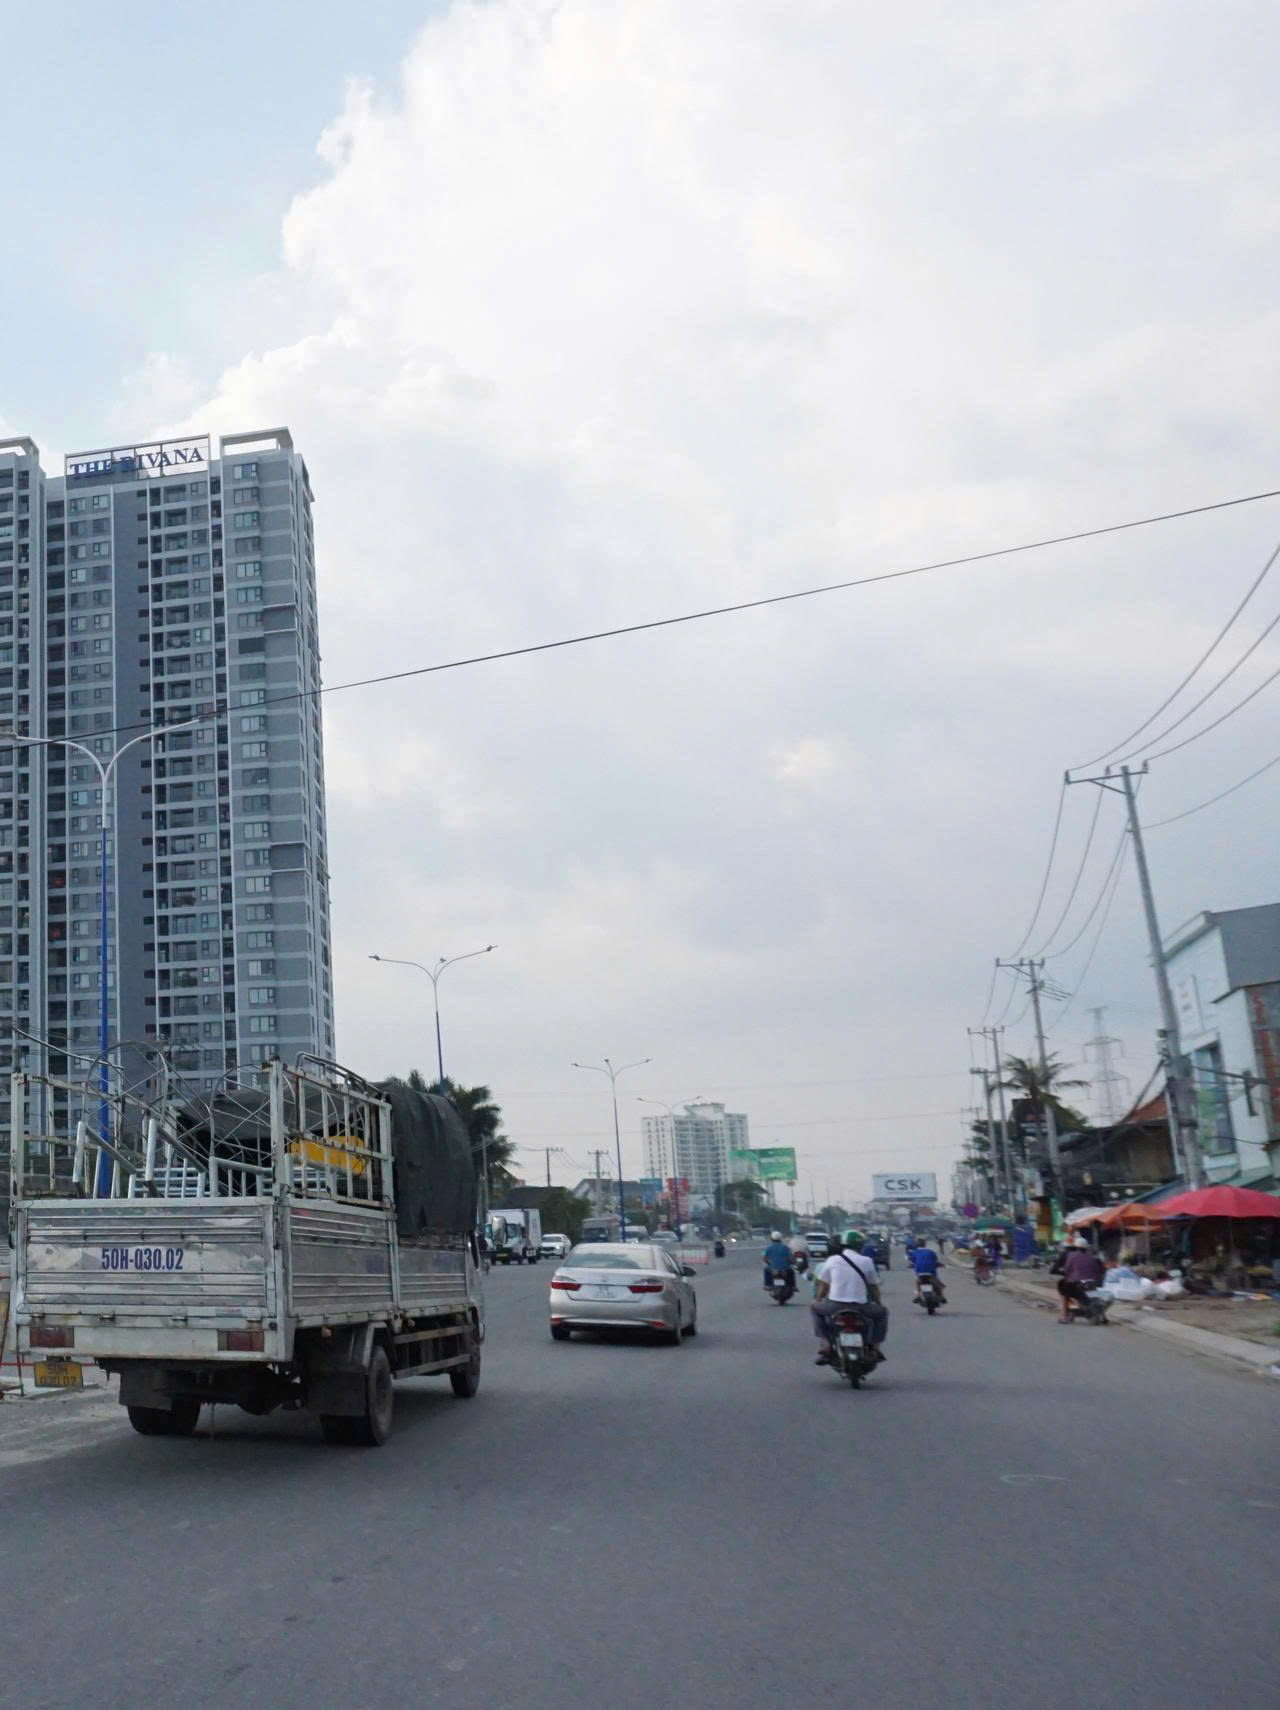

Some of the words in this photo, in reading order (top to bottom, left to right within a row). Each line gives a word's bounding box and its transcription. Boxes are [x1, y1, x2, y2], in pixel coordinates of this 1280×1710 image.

[69, 460, 113, 480] THE
[119, 447, 204, 473] RIVANA
[884, 1178, 922, 1191] CSK
[101, 1247, 184, 1270] 50H-030.02
